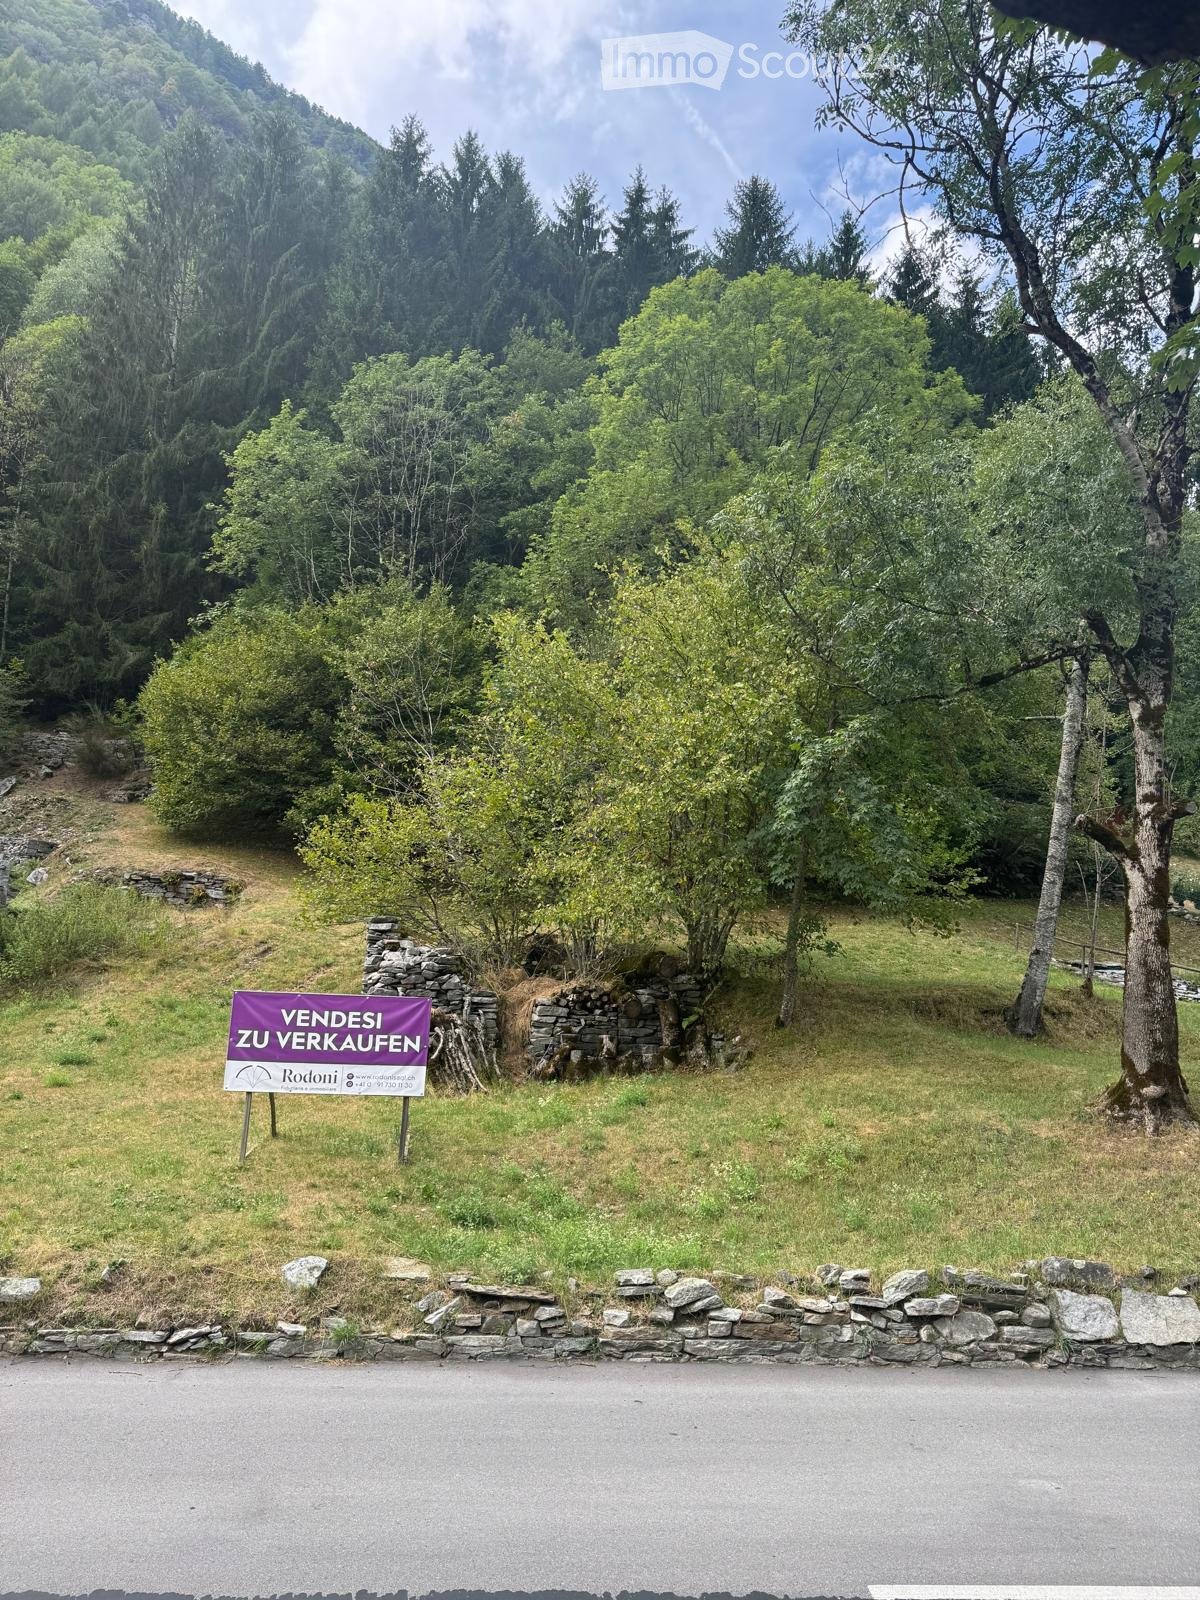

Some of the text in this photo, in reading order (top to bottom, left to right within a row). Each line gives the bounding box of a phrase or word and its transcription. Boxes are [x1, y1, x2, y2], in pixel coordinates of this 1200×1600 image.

[280, 1008, 383, 1030] VENDESI
[235, 1029, 421, 1053] ZU VERKAUFEN
[282, 1068, 338, 1083] Rodoni
